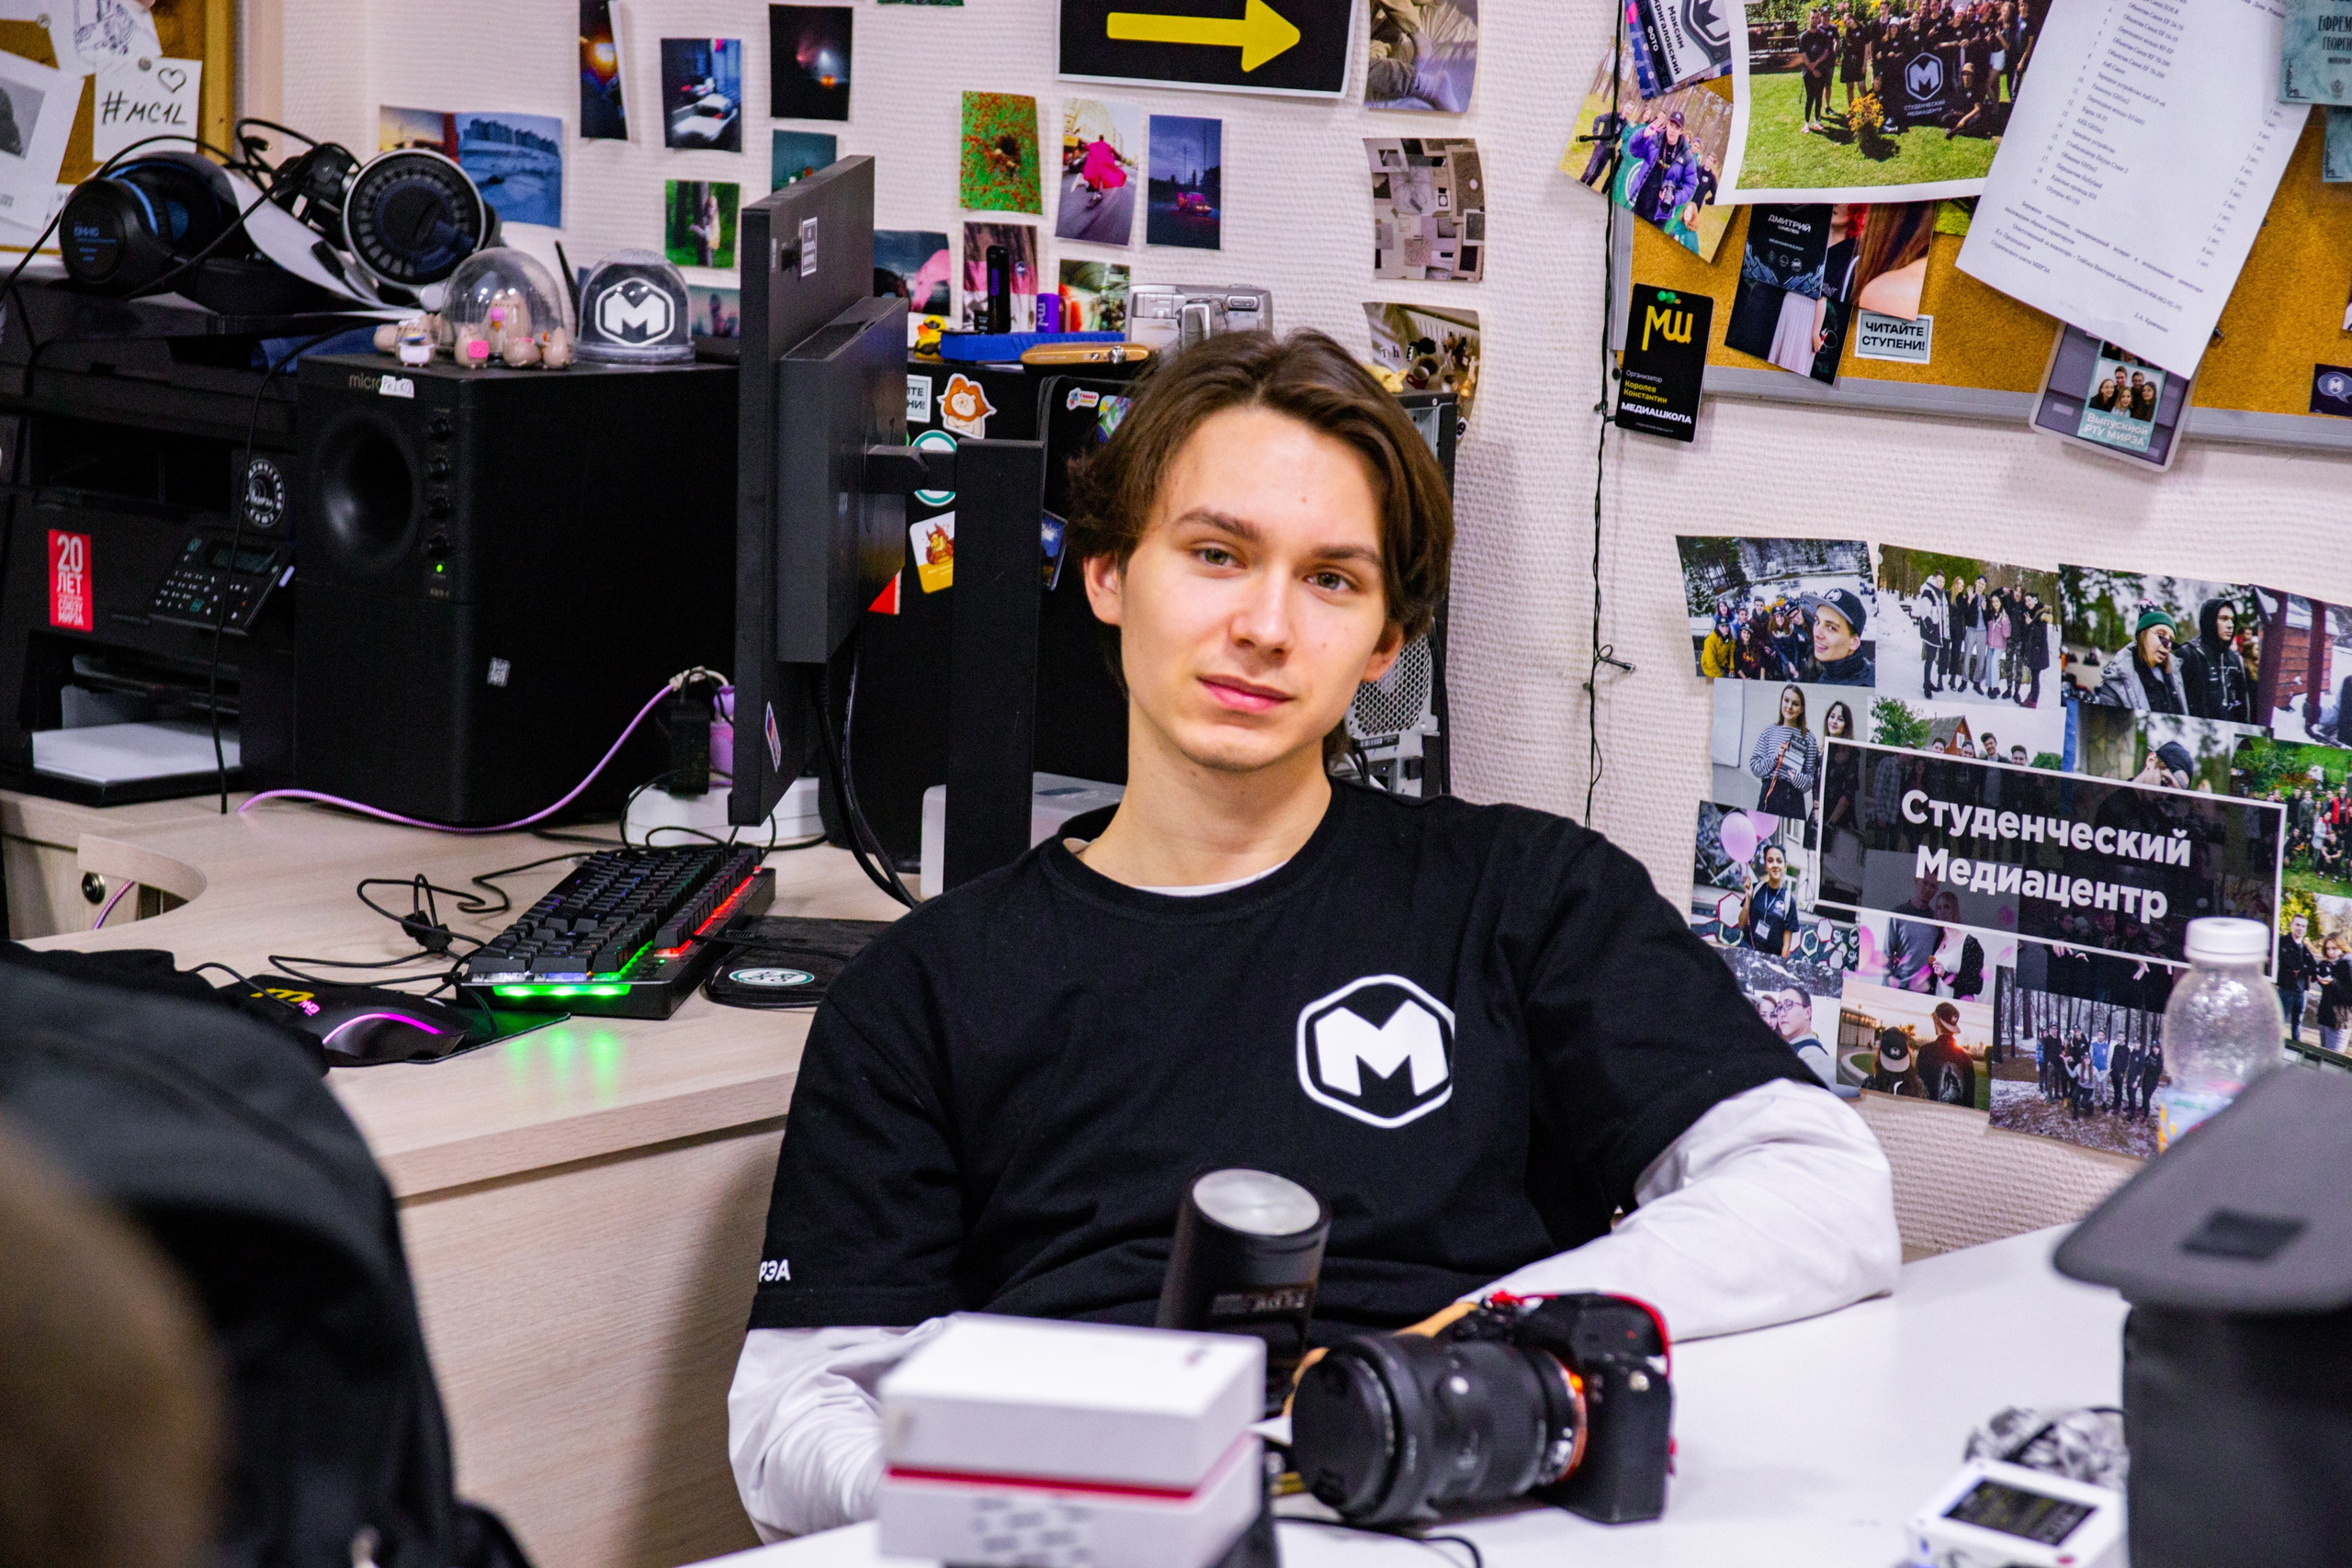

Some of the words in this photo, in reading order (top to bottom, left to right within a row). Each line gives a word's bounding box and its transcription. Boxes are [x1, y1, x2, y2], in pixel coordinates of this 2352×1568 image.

[1647, 26, 1659, 51] ФОТО
[1668, 6, 1684, 50] Максим
[1768, 214, 1812, 232] ДМИТРИЙ
[1865, 321, 1925, 337] ЧИТАЙТЕ
[1861, 335, 1926, 352] СТУПЕНИ!
[1624, 379, 1657, 393] Королев
[1625, 369, 1663, 383] Организатор
[1623, 389, 1668, 404] Константин
[1621, 401, 1692, 424] МЕДИАШКОЛА
[2086, 412, 2150, 436] Выпускной
[2084, 423, 2104, 437] РТУ
[2107, 430, 2145, 447] МИРЭА
[57, 534, 84, 573] 20
[57, 570, 84, 596] ЛЕТ
[1901, 789, 2192, 867] Студенческий
[1915, 844, 2169, 924] Медиацентр
